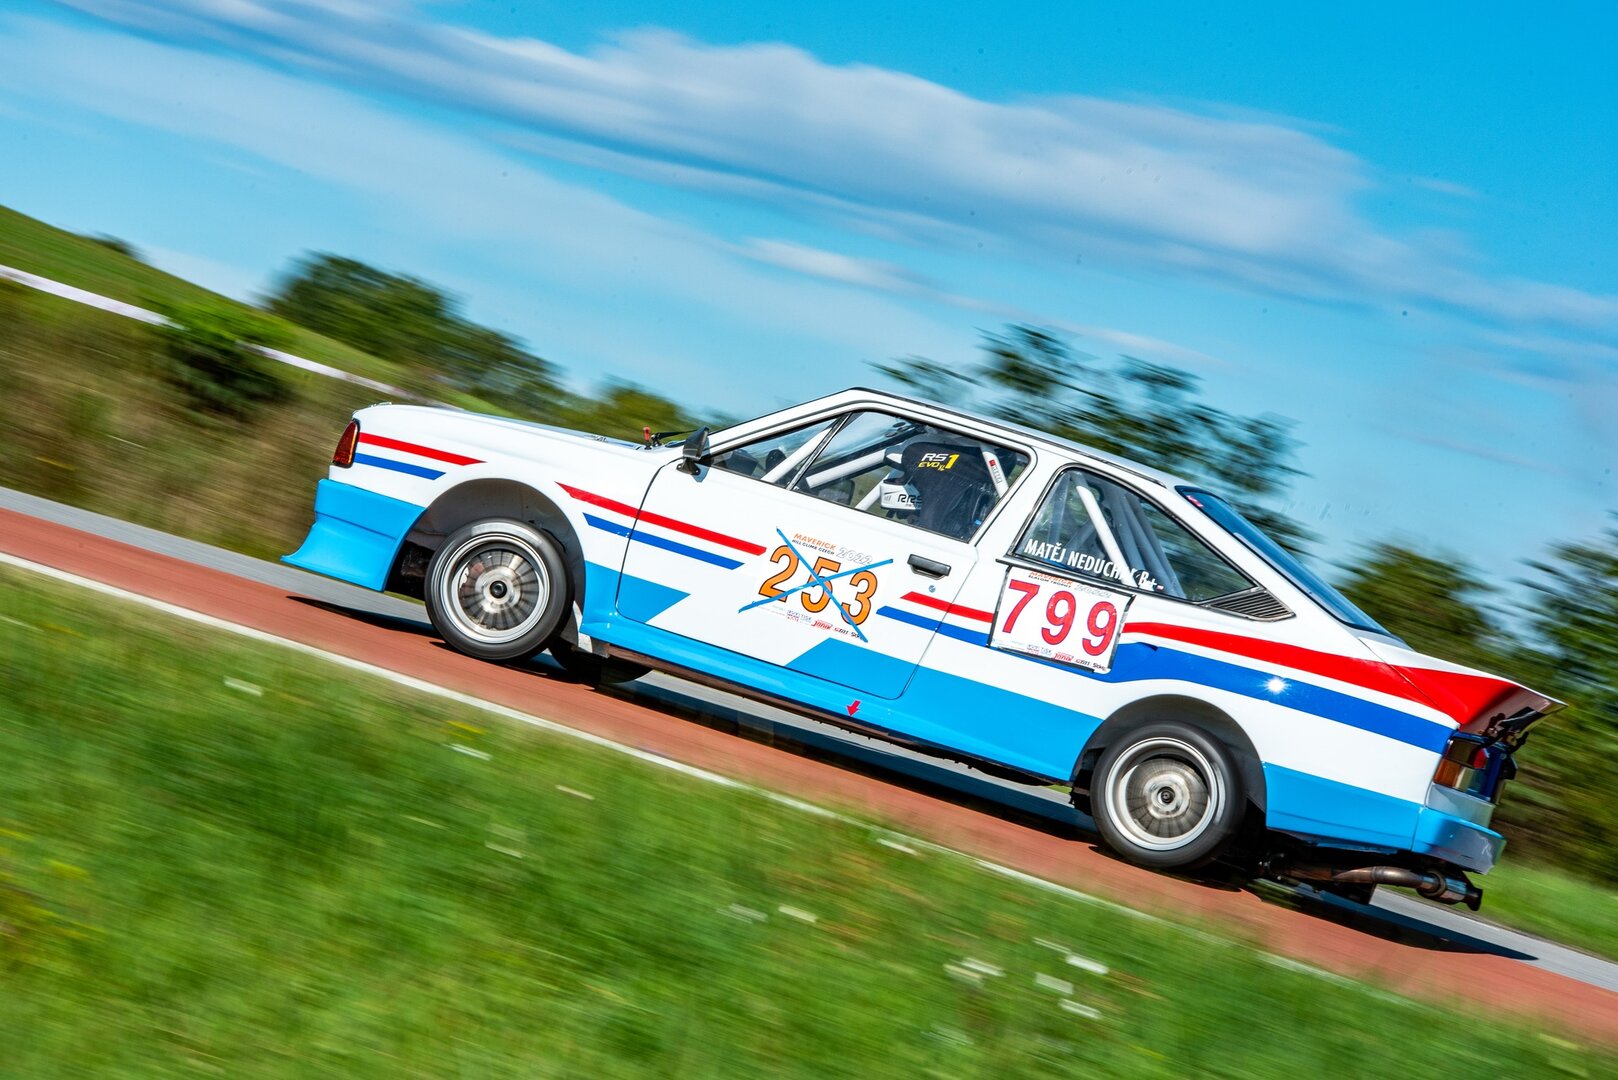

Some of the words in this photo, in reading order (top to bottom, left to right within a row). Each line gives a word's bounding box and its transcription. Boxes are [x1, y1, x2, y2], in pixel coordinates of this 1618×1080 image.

[793, 533, 837, 550] MAVERICK
[802, 542, 818, 550] CLIMB
[818, 546, 835, 555] CZECH
[1024, 539, 1067, 563] MATĚJ
[836, 547, 873, 565] 2022
[758, 545, 878, 626] 253
[1002, 579, 1118, 656] 799
